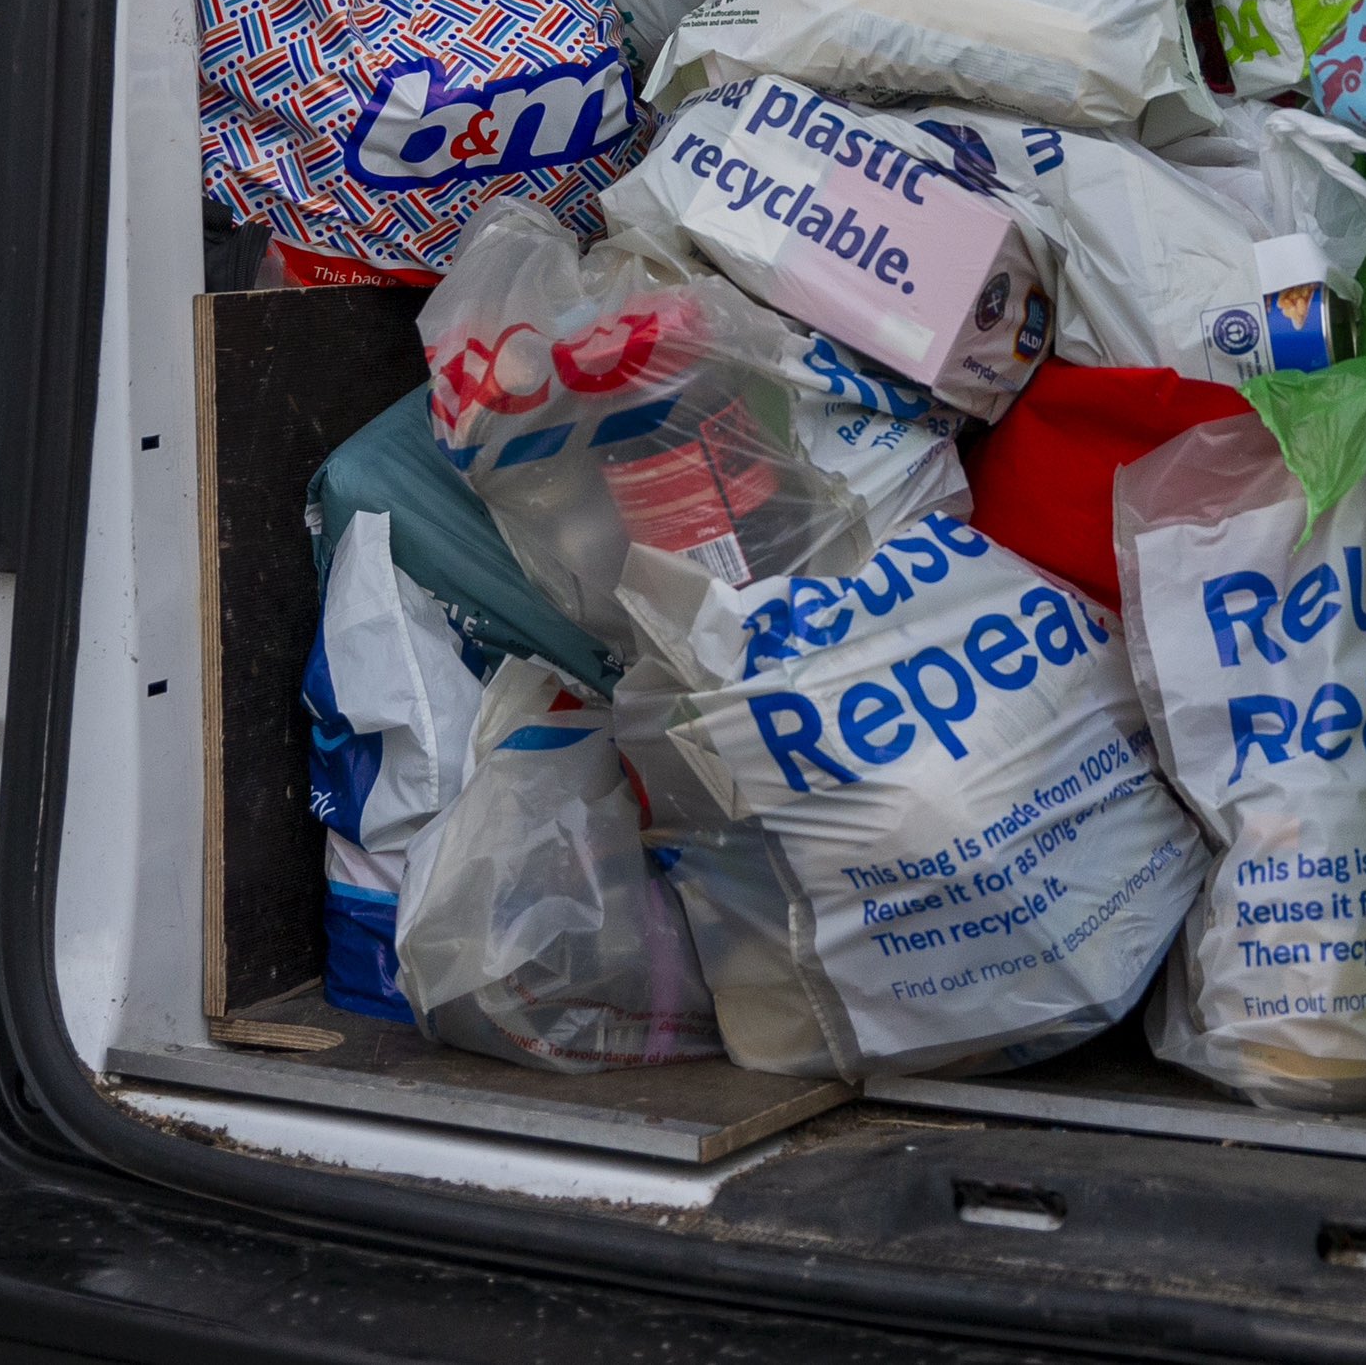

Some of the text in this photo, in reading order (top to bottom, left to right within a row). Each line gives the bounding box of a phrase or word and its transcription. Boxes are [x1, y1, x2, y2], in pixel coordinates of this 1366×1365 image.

[691, 20, 708, 28] babies
[735, 17, 759, 26] children.
[742, 9, 760, 17] please
[358, 60, 634, 179] b&m
[745, 83, 940, 206] plastic
[671, 132, 917, 296] recyclable.
[314, 265, 348, 285] This
[963, 355, 999, 385] Everyday
[841, 864, 898, 890] This
[897, 849, 957, 880] bag
[953, 837, 983, 862] is
[982, 802, 1042, 848] made
[1034, 773, 1083, 810] from
[1079, 738, 1129, 786] 100%
[862, 816, 1077, 925] Reuse it for as long
[1237, 856, 1290, 887] This
[1297, 852, 1351, 884] bag
[871, 874, 1069, 956] Then recycle it.
[891, 839, 1183, 1001] Find out more at tesco.com/recycling
[1237, 900, 1324, 928] Reuse
[1332, 891, 1354, 920] it
[1238, 939, 1311, 967] Then
[1243, 993, 1290, 1017] Find
[1295, 993, 1327, 1014] out
[548, 1045, 563, 1057] To
[565, 1049, 601, 1063] avoid
[603, 1050, 644, 1066] danger
